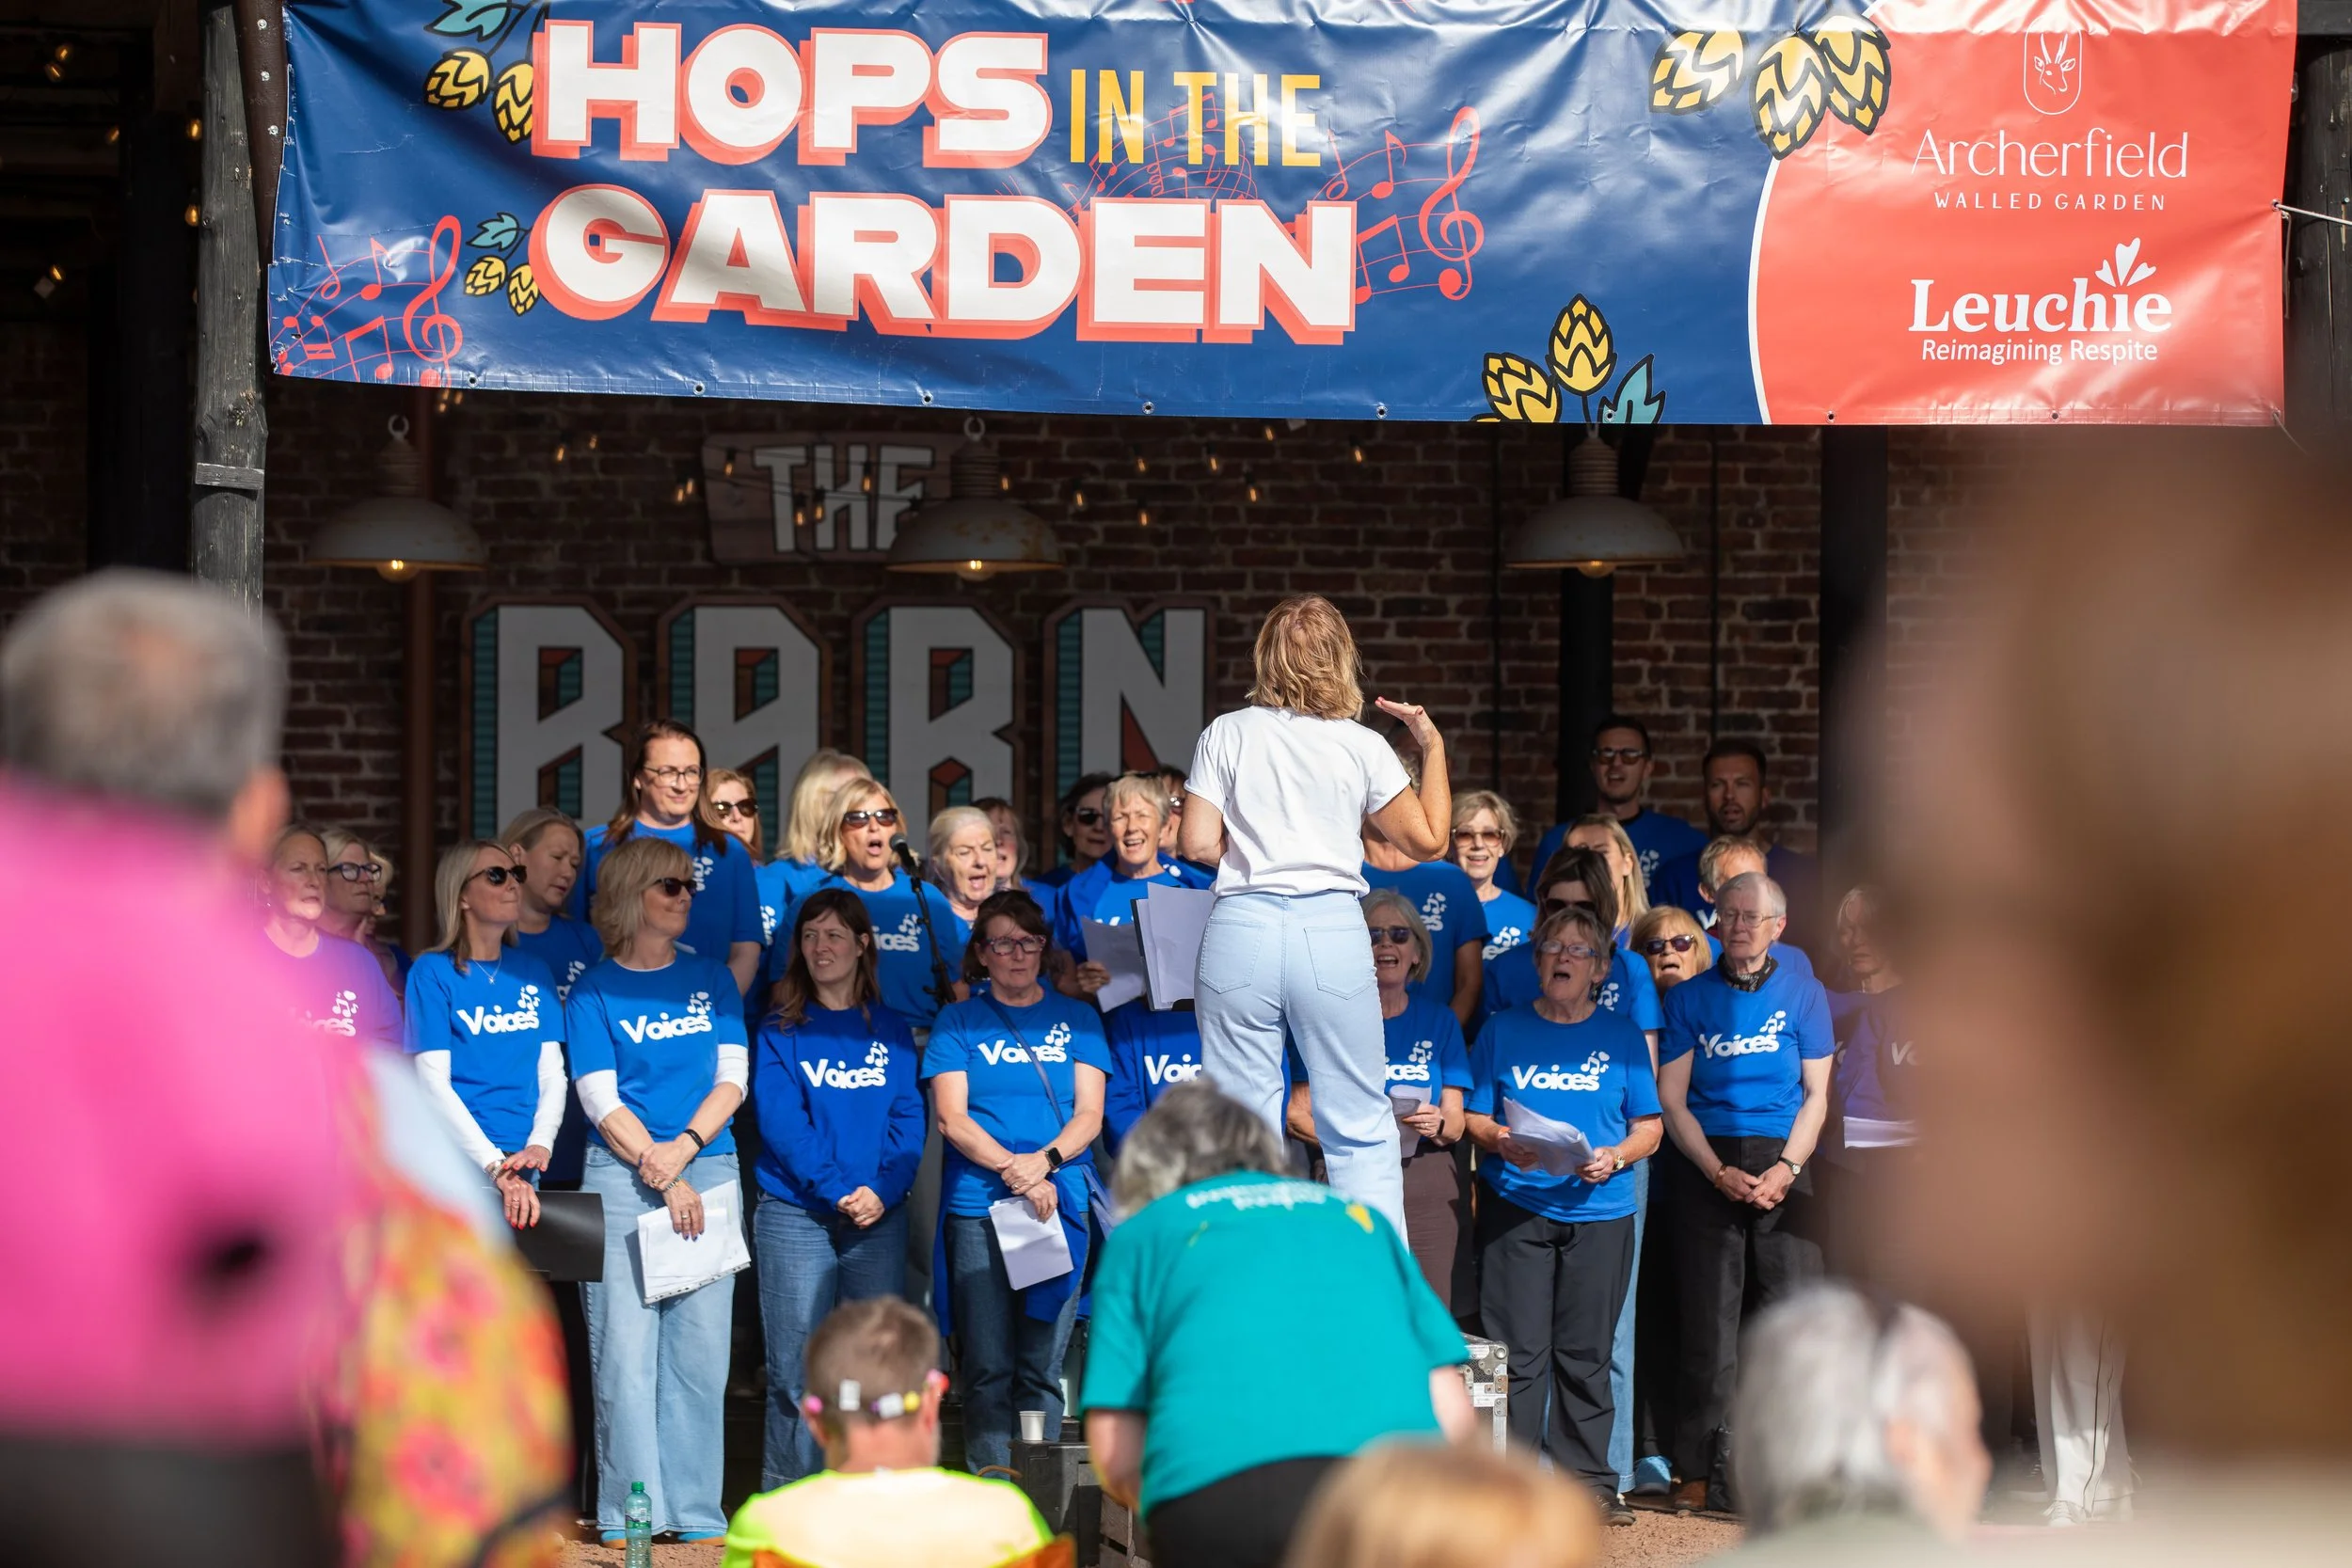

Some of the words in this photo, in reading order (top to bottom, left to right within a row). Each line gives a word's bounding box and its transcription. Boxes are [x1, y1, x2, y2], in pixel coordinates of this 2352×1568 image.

[532, 20, 1052, 168] HOPS
[1071, 70, 1144, 164] IN
[1174, 71, 1321, 167] THE
[1911, 127, 2189, 178] Archerfield
[1934, 191, 2042, 211] WALLED
[2054, 193, 2166, 211] GARDEN
[529, 183, 1358, 344] GARDEN
[1908, 276, 2172, 333] Leuchie
[1921, 338, 2062, 365] Reimagining
[2070, 339, 2158, 365] Respite
[755, 445, 933, 552] THE
[473, 604, 1205, 842] BARN
[872, 925, 920, 952] ices
[456, 1005, 540, 1036] Voices
[618, 1012, 713, 1044] Voices
[1698, 1033, 1780, 1059] Voices
[800, 1058, 887, 1089] Voices
[1144, 1053, 1202, 1085] Voic
[1385, 1054, 1431, 1081] ices
[1512, 1064, 1600, 1091] Voices
